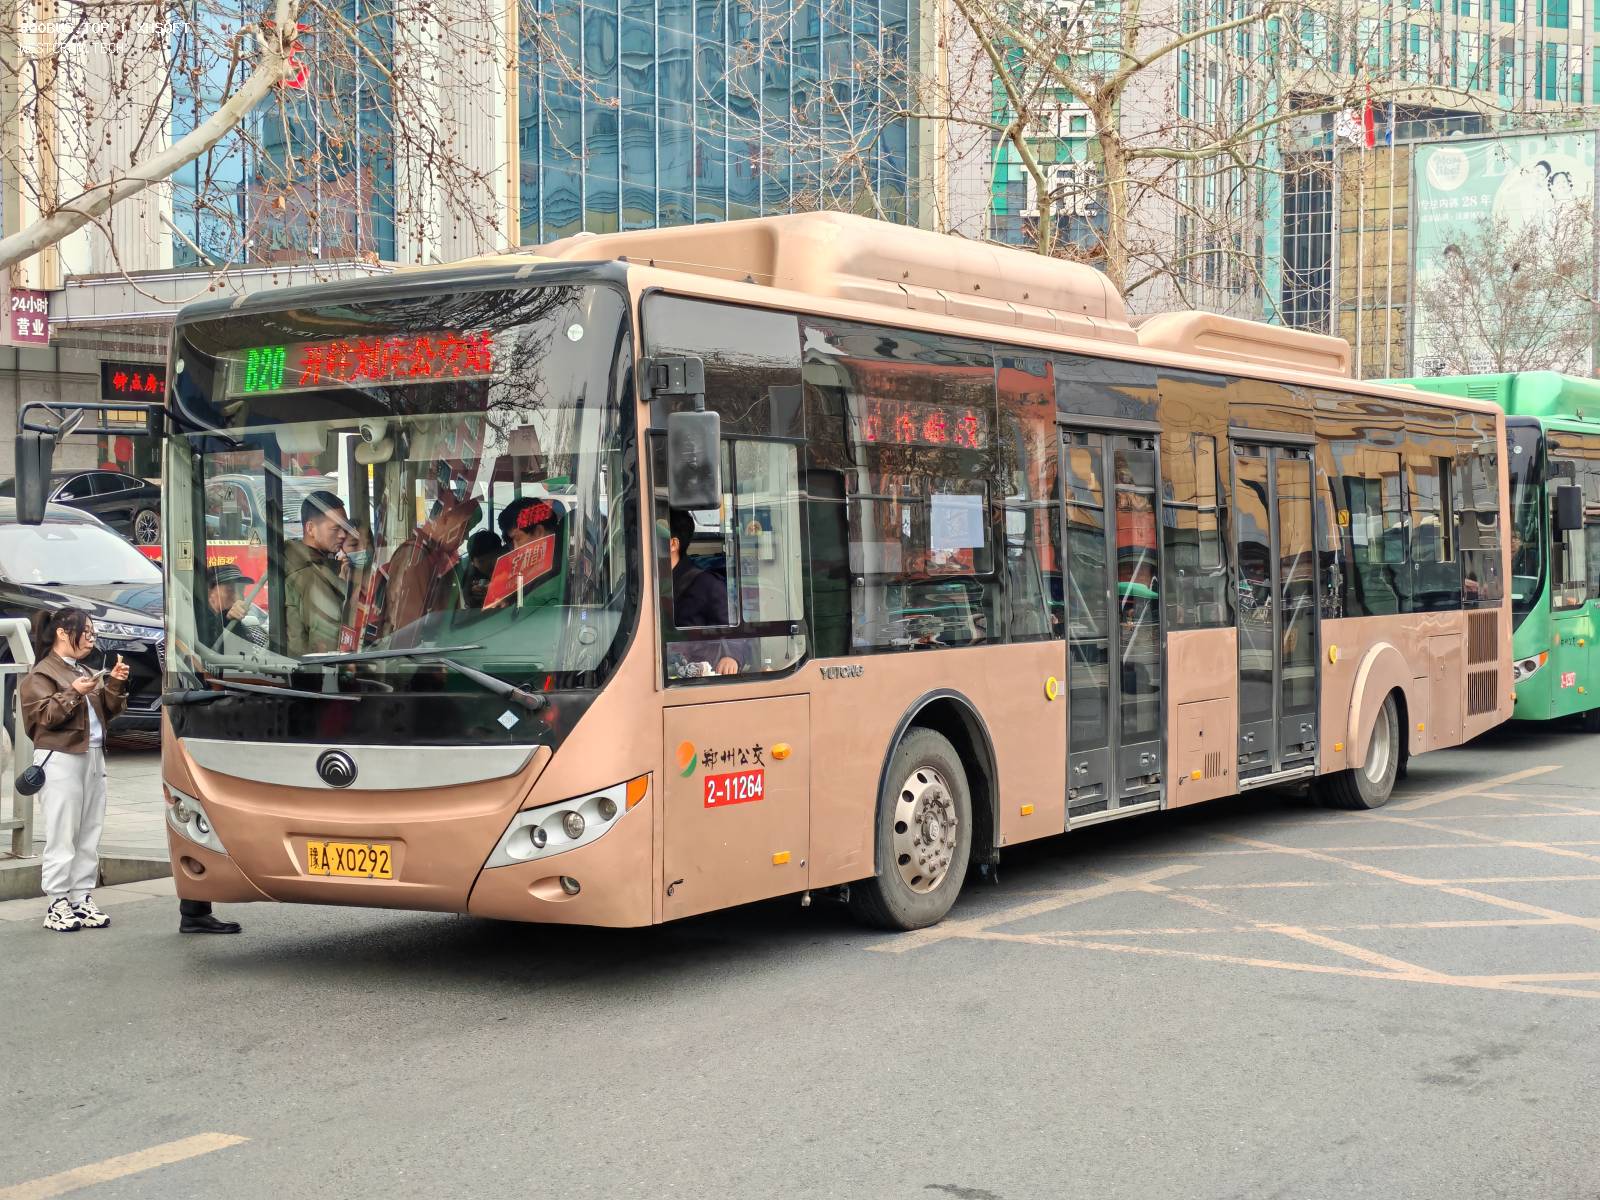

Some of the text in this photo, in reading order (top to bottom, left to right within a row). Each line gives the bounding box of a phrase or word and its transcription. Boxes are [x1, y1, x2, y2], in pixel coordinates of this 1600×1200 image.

[12, 296, 48, 315] 24小时
[16, 317, 45, 336] 营业
[244, 330, 495, 392] B20 开往刘庄公交站
[819, 664, 865, 680] YUTONG
[701, 743, 766, 767] 郑州公交
[707, 773, 763, 803] 2-11264
